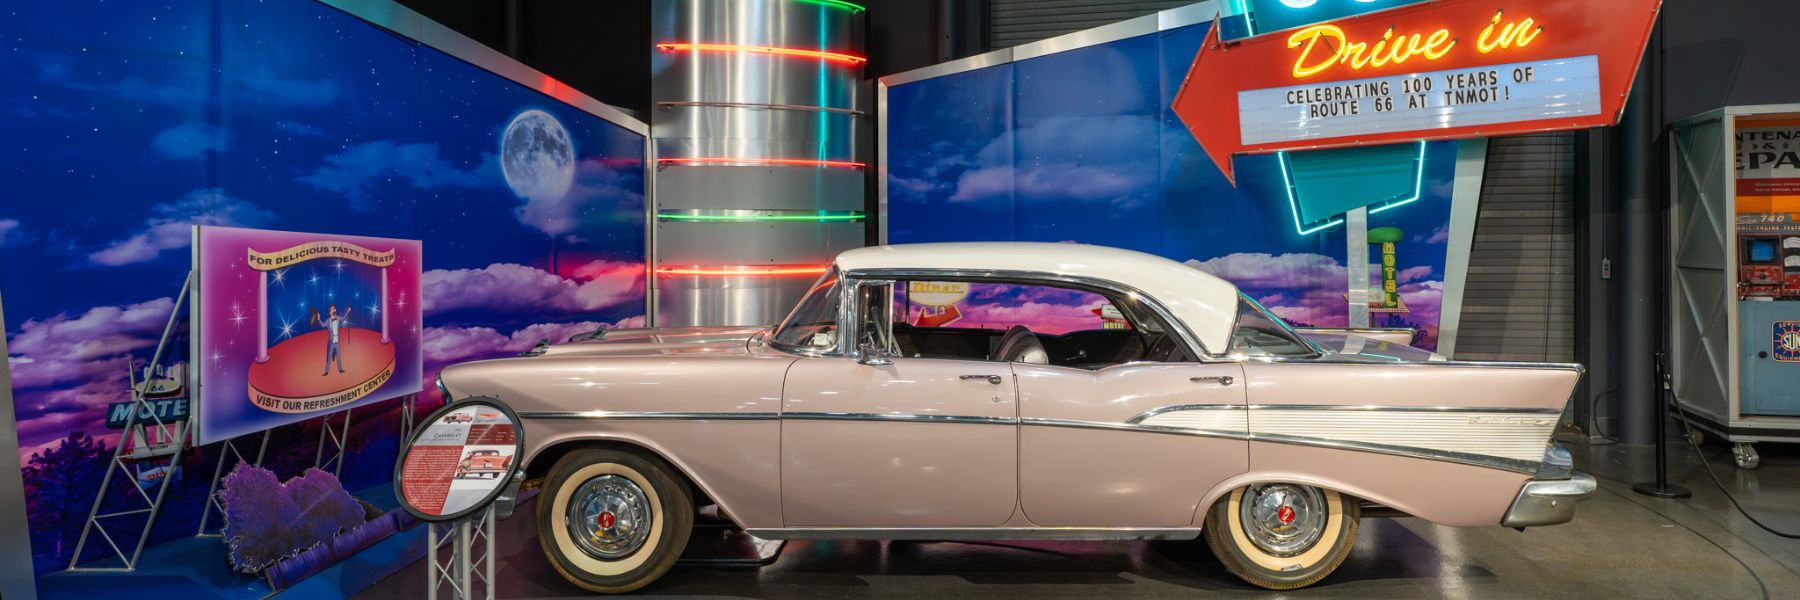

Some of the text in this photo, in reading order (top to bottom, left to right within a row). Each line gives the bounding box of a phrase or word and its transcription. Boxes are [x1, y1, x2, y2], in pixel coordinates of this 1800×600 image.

[1287, 10, 1543, 79] Drive in
[1286, 66, 1535, 106] CELEBRATING 100 YEARS OF
[1310, 86, 1511, 119] ROUTE 66 AT TNMOT!
[1759, 214, 1785, 223] 740
[249, 245, 394, 266] FOR DELICIOUS TASTY TREATS
[1383, 242, 1396, 306] MOTEL
[256, 369, 392, 411] VISIT OUR REFRESHMENT CENTER
